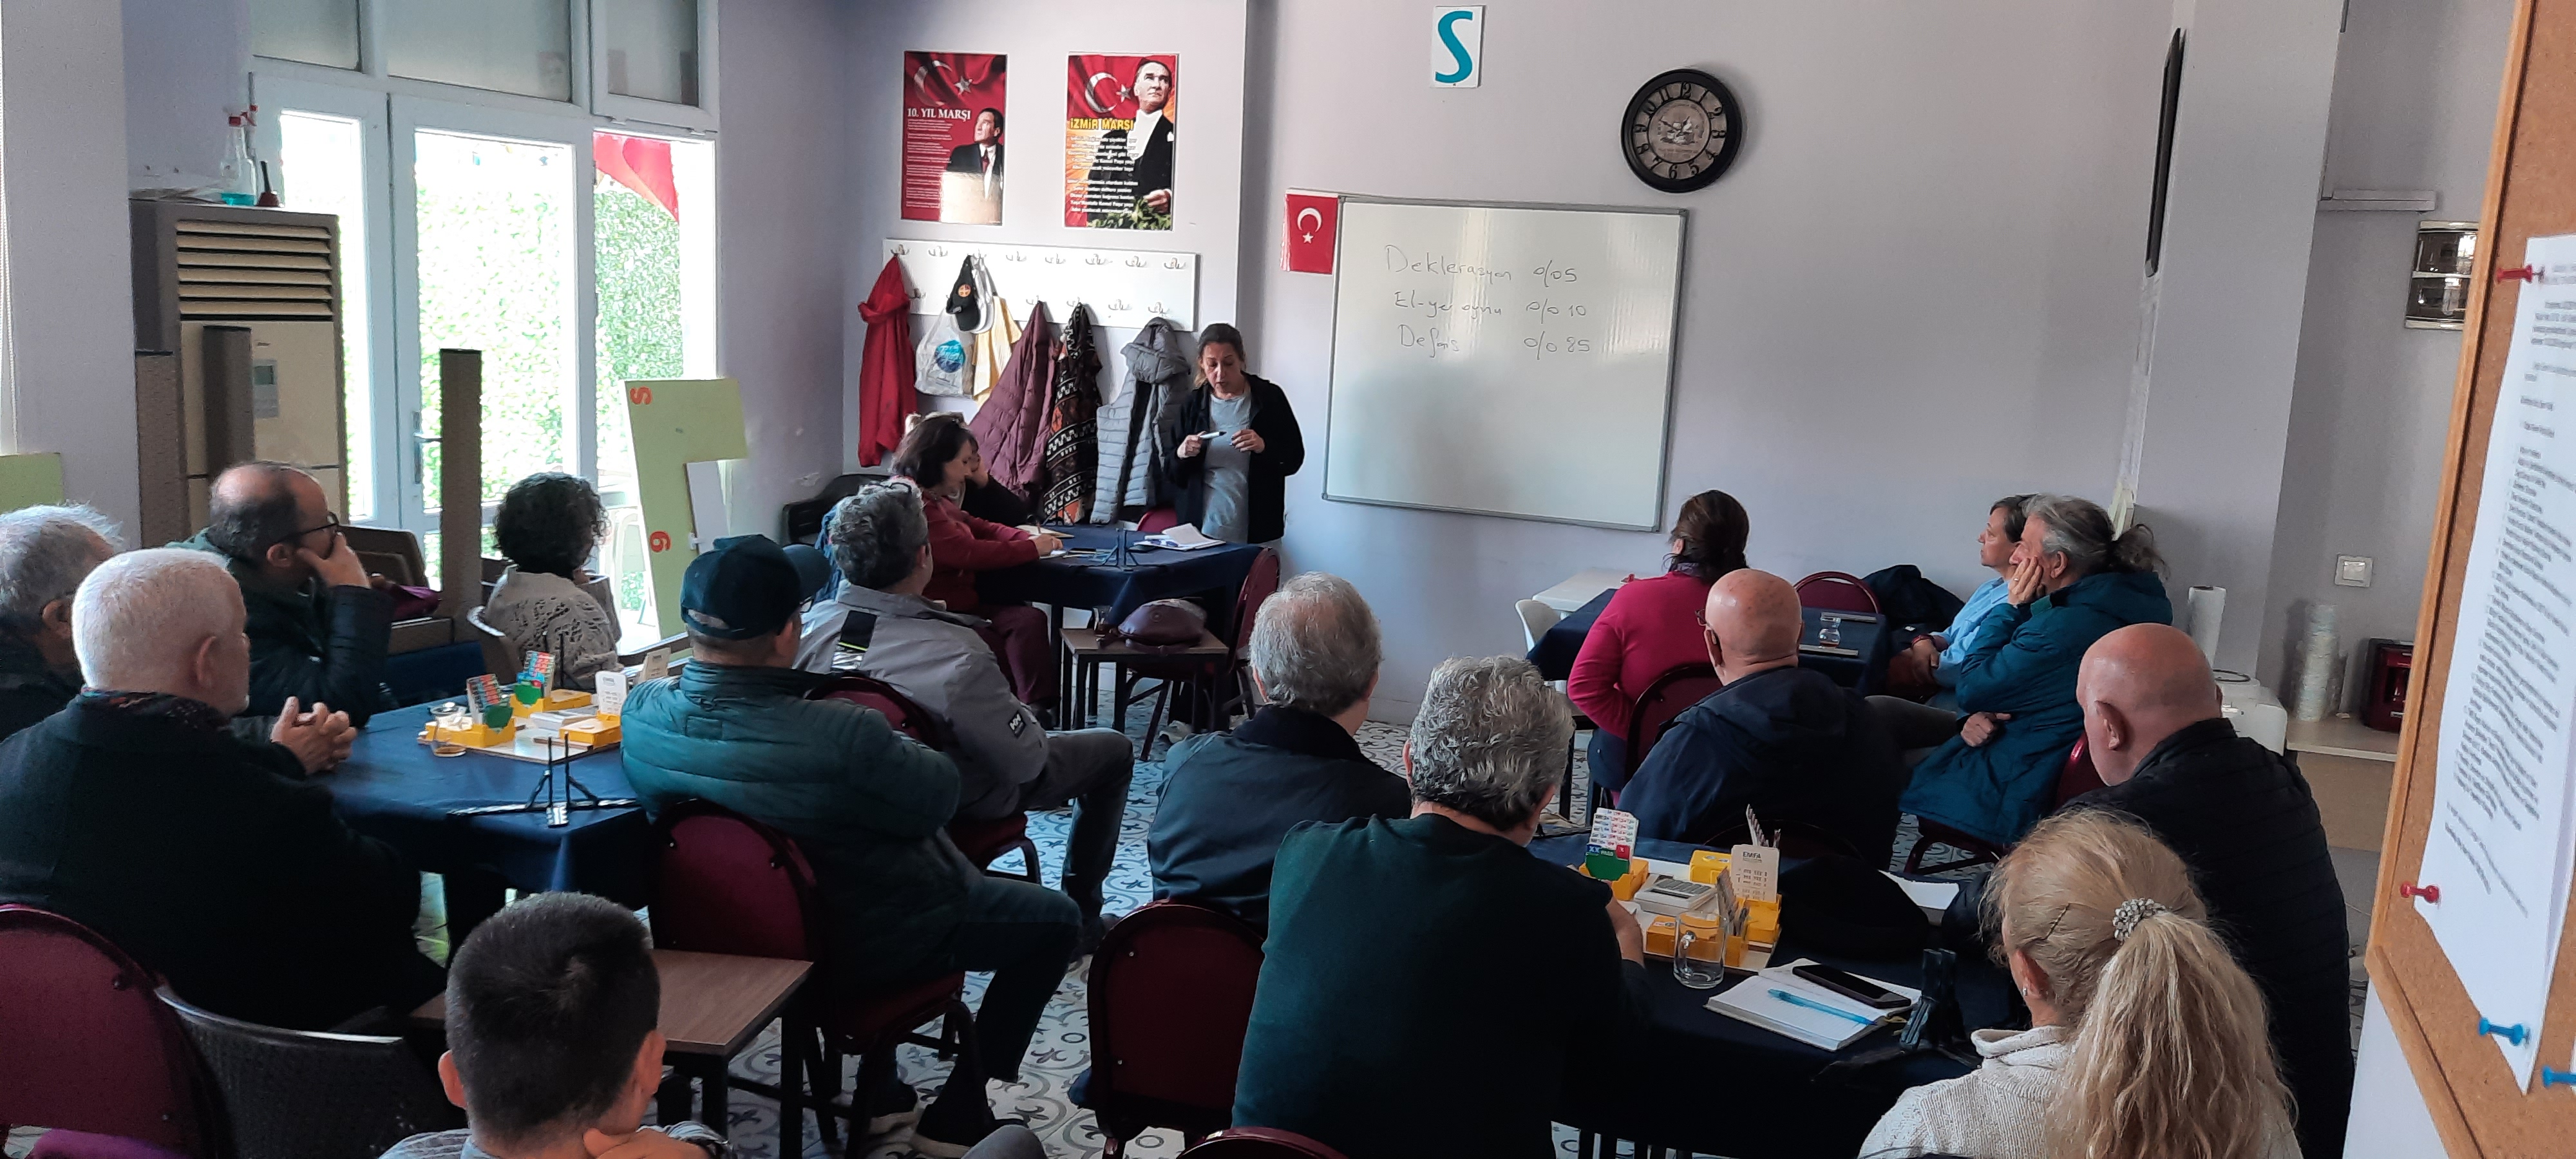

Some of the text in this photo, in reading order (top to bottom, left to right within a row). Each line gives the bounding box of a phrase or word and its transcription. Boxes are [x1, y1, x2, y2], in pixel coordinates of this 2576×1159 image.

[1435, 10, 1473, 83] S
[907, 108, 971, 122] 10. YIL MARŞI
[1101, 118, 1134, 132] MARŞI
[1385, 244, 1512, 285] Deklerasyon
